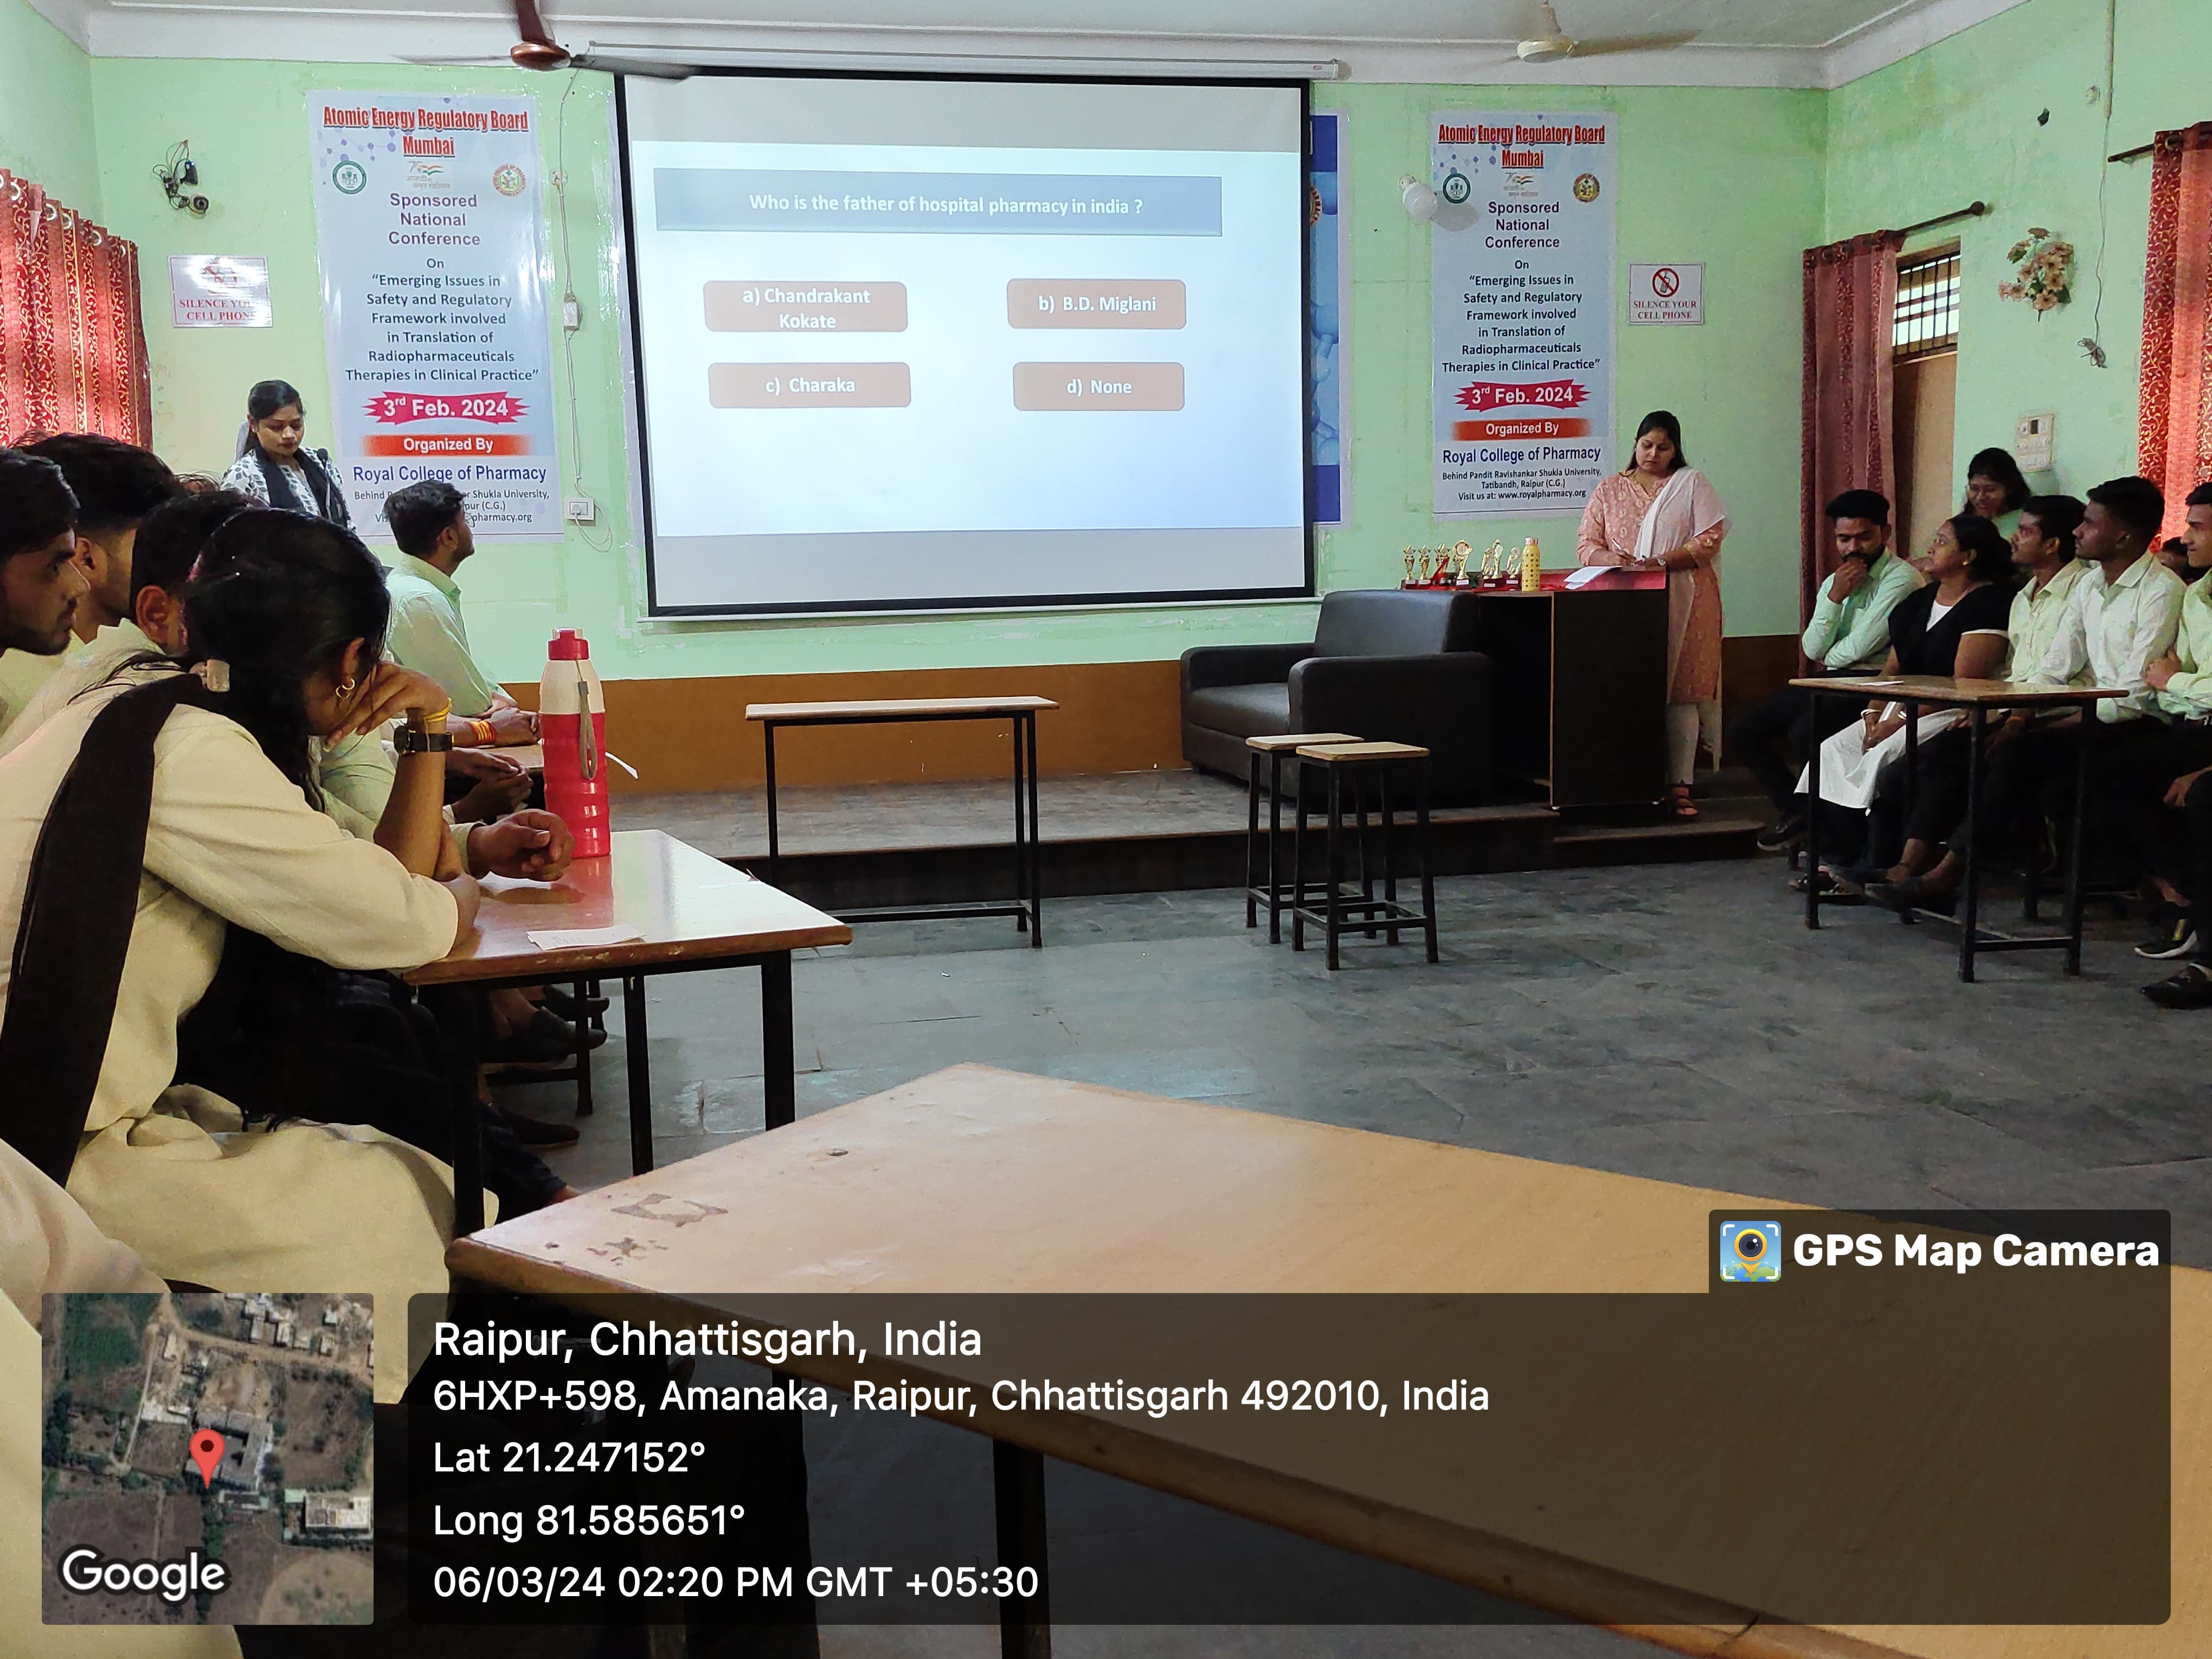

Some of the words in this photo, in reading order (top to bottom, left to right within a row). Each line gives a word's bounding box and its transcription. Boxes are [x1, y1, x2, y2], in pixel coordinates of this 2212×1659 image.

[324, 106, 369, 127] Atomic
[372, 108, 415, 129] Energy
[418, 109, 487, 131] Regulatory
[491, 111, 528, 131] Board
[1438, 124, 1476, 143] Atomic
[1478, 125, 1513, 144] Energy
[1515, 125, 1572, 145] Regulatory
[1574, 125, 1605, 144] Board
[403, 136, 455, 156] Mumbai
[1502, 150, 1544, 169] Mumbai
[390, 193, 477, 209] Sponsored
[750, 194, 789, 209] Who
[794, 195, 807, 209] is
[811, 196, 839, 210] the
[843, 196, 894, 211] father
[899, 196, 915, 212] of
[919, 197, 984, 215] hospital
[989, 197, 1068, 216] pharmacy
[1072, 199, 1086, 213] in
[1091, 199, 1129, 214] india
[1135, 200, 1143, 214] ?
[1489, 202, 1559, 215] Sponsored
[401, 213, 466, 226] National
[1496, 219, 1549, 230] National
[389, 232, 480, 245] Conference
[1486, 237, 1560, 248] Conference
[427, 259, 444, 268] On
[1515, 261, 1529, 269] On
[445, 275, 485, 286] Issues
[489, 276, 500, 286] in
[1529, 275, 1560, 285] Issues
[1564, 275, 1573, 285] in
[179, 299, 228, 308] SILENCE
[367, 294, 408, 306] Safety
[413, 294, 436, 305] and
[441, 294, 511, 307] Regulatory
[743, 288, 760, 306] a)
[764, 288, 870, 304] Chandrakant
[1464, 293, 1497, 304] Safety
[1501, 293, 1521, 302] and
[1525, 292, 1581, 304] Regulatory
[1039, 295, 1054, 313] b)
[1063, 296, 1095, 311] B.D.
[1099, 296, 1156, 314] Miglani
[187, 312, 216, 320] CELL
[372, 313, 446, 324] Framework
[451, 313, 505, 324] involved
[1467, 310, 1528, 321] Framework
[1532, 308, 1576, 319] involved
[779, 314, 836, 329] Kokate
[388, 332, 399, 342] in
[403, 332, 475, 343] Translation
[481, 332, 493, 343] of
[1478, 328, 1488, 337] in
[1491, 326, 1551, 337] Translation
[1555, 325, 1566, 336] of
[1462, 342, 1581, 356] Radiopharmaceuticals
[369, 351, 514, 364] Radiopharmaceuticals
[1442, 362, 1495, 374] Therapies
[1499, 362, 1508, 371] in
[1512, 360, 1549, 371] Clinical
[345, 370, 410, 382] Therapies
[415, 370, 426, 381] in
[431, 370, 477, 381] Clinical
[766, 377, 780, 395] c)
[789, 377, 856, 393] Charaka
[1067, 379, 1083, 396] d)
[1091, 381, 1132, 393] None
[1472, 386, 1490, 404] 3rd
[1495, 388, 1529, 403] Feb.
[1535, 387, 1573, 402] 2024
[384, 396, 406, 416] 3rd
[413, 400, 455, 416] Feb.
[462, 400, 509, 416] 2024
[1486, 422, 1541, 437] Organized
[1545, 422, 1559, 435] By
[404, 438, 472, 452] Organized
[477, 439, 493, 453] By
[1443, 449, 1476, 467] Royal
[1481, 448, 1524, 464] College
[1528, 447, 1540, 460] of
[1543, 447, 1600, 463] Pharmacy
[353, 466, 394, 485] Royal
[399, 466, 452, 482] College
[458, 466, 471, 480] of
[477, 466, 546, 483] Pharmacy
[1539, 468, 1562, 477] Shukla
[1565, 467, 1601, 477] University,
[1481, 480, 1519, 489] Tatibandh,
[1546, 479, 1565, 488] (C.G.)
[355, 491, 384, 499] Behind
[473, 490, 501, 499] Shukla
[504, 490, 549, 500] University,
[1499, 490, 1586, 500] www.royalpharmacy.org
[465, 503, 478, 511] pur
[482, 501, 506, 511] (C.G.)
[472, 514, 532, 524] pharmacy.org
